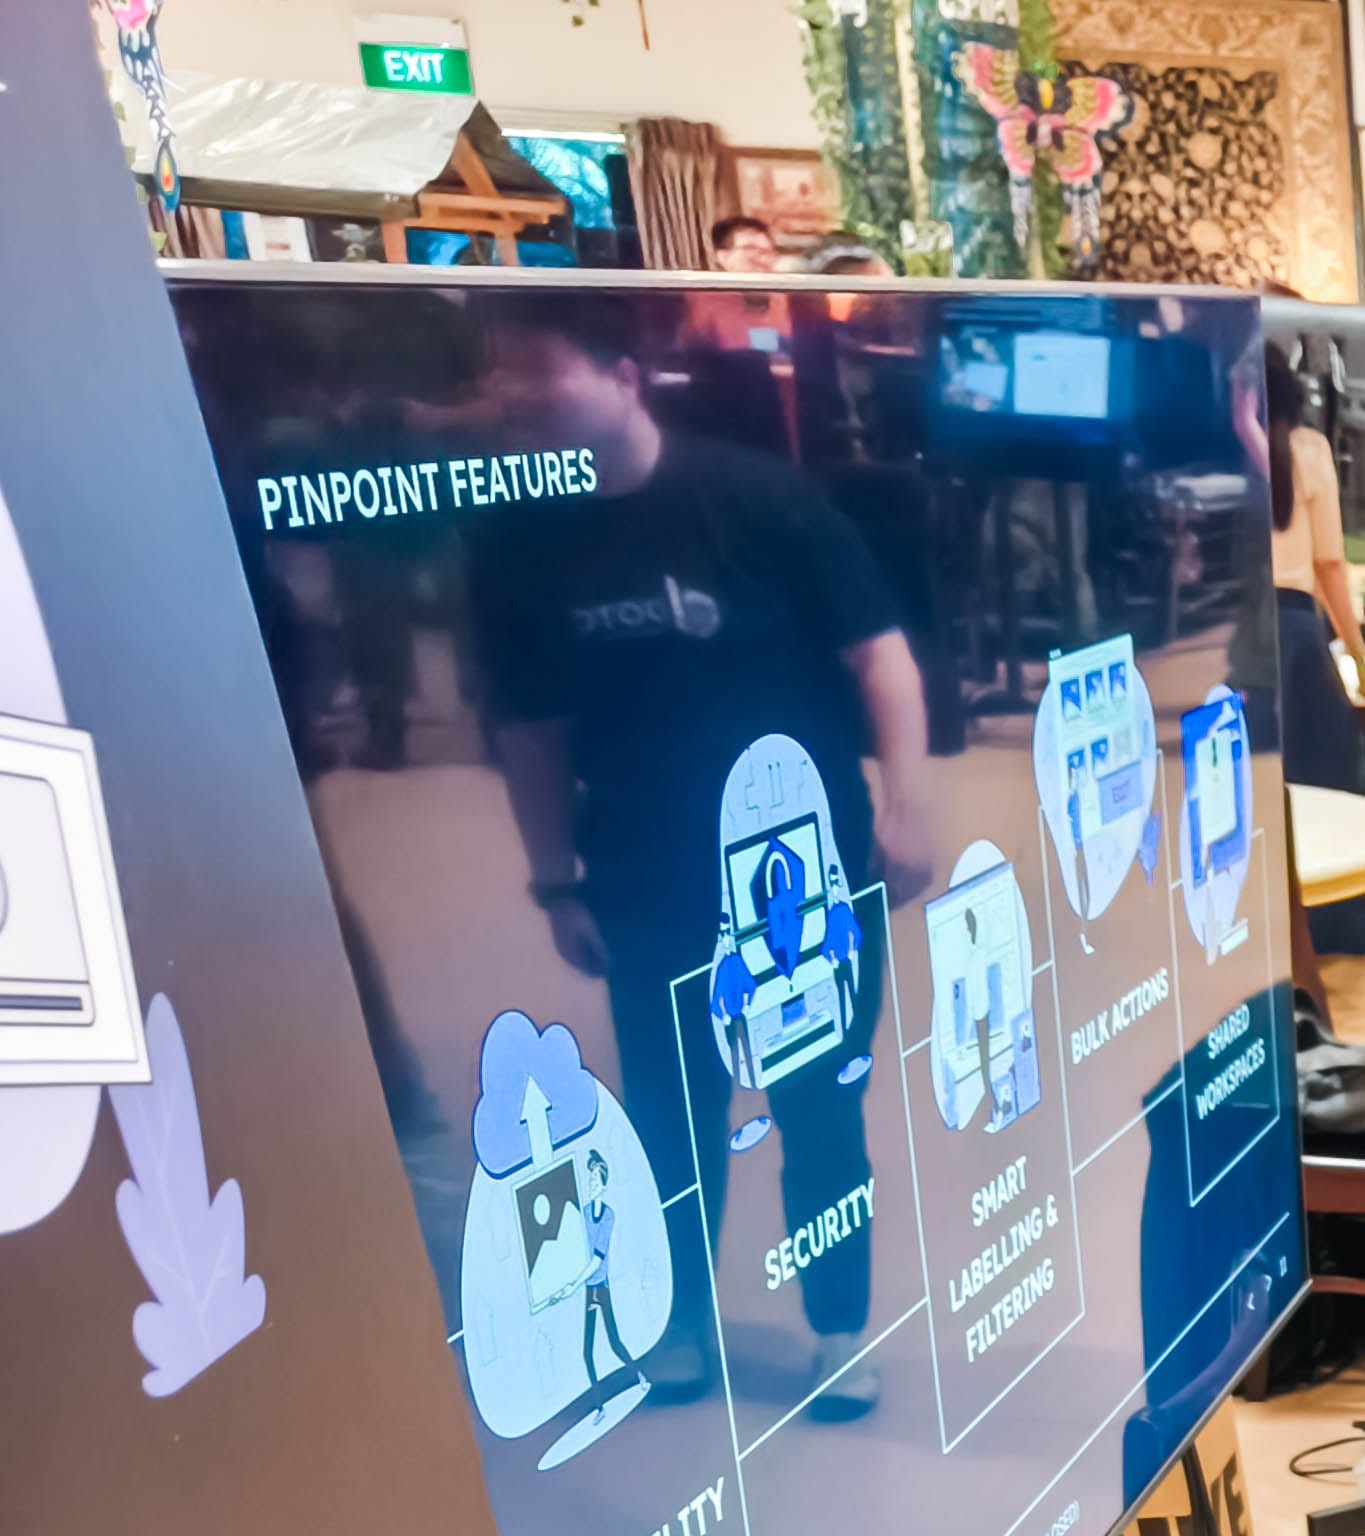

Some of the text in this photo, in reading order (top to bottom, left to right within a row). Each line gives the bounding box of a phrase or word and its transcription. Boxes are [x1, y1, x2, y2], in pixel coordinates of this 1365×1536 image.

[384, 50, 444, 84] EXIT
[257, 447, 598, 530] PINPOINT FEATURES
[1070, 968, 1169, 1064] BULK ACTIONS
[1208, 1004, 1250, 1060] SHARED
[1195, 1043, 1266, 1120] WORKSPACES
[971, 1155, 1027, 1227] SMART
[765, 1177, 875, 1290] SECURITY
[948, 1194, 1059, 1313] LABELLING &
[966, 1258, 1055, 1363] FILTERING
